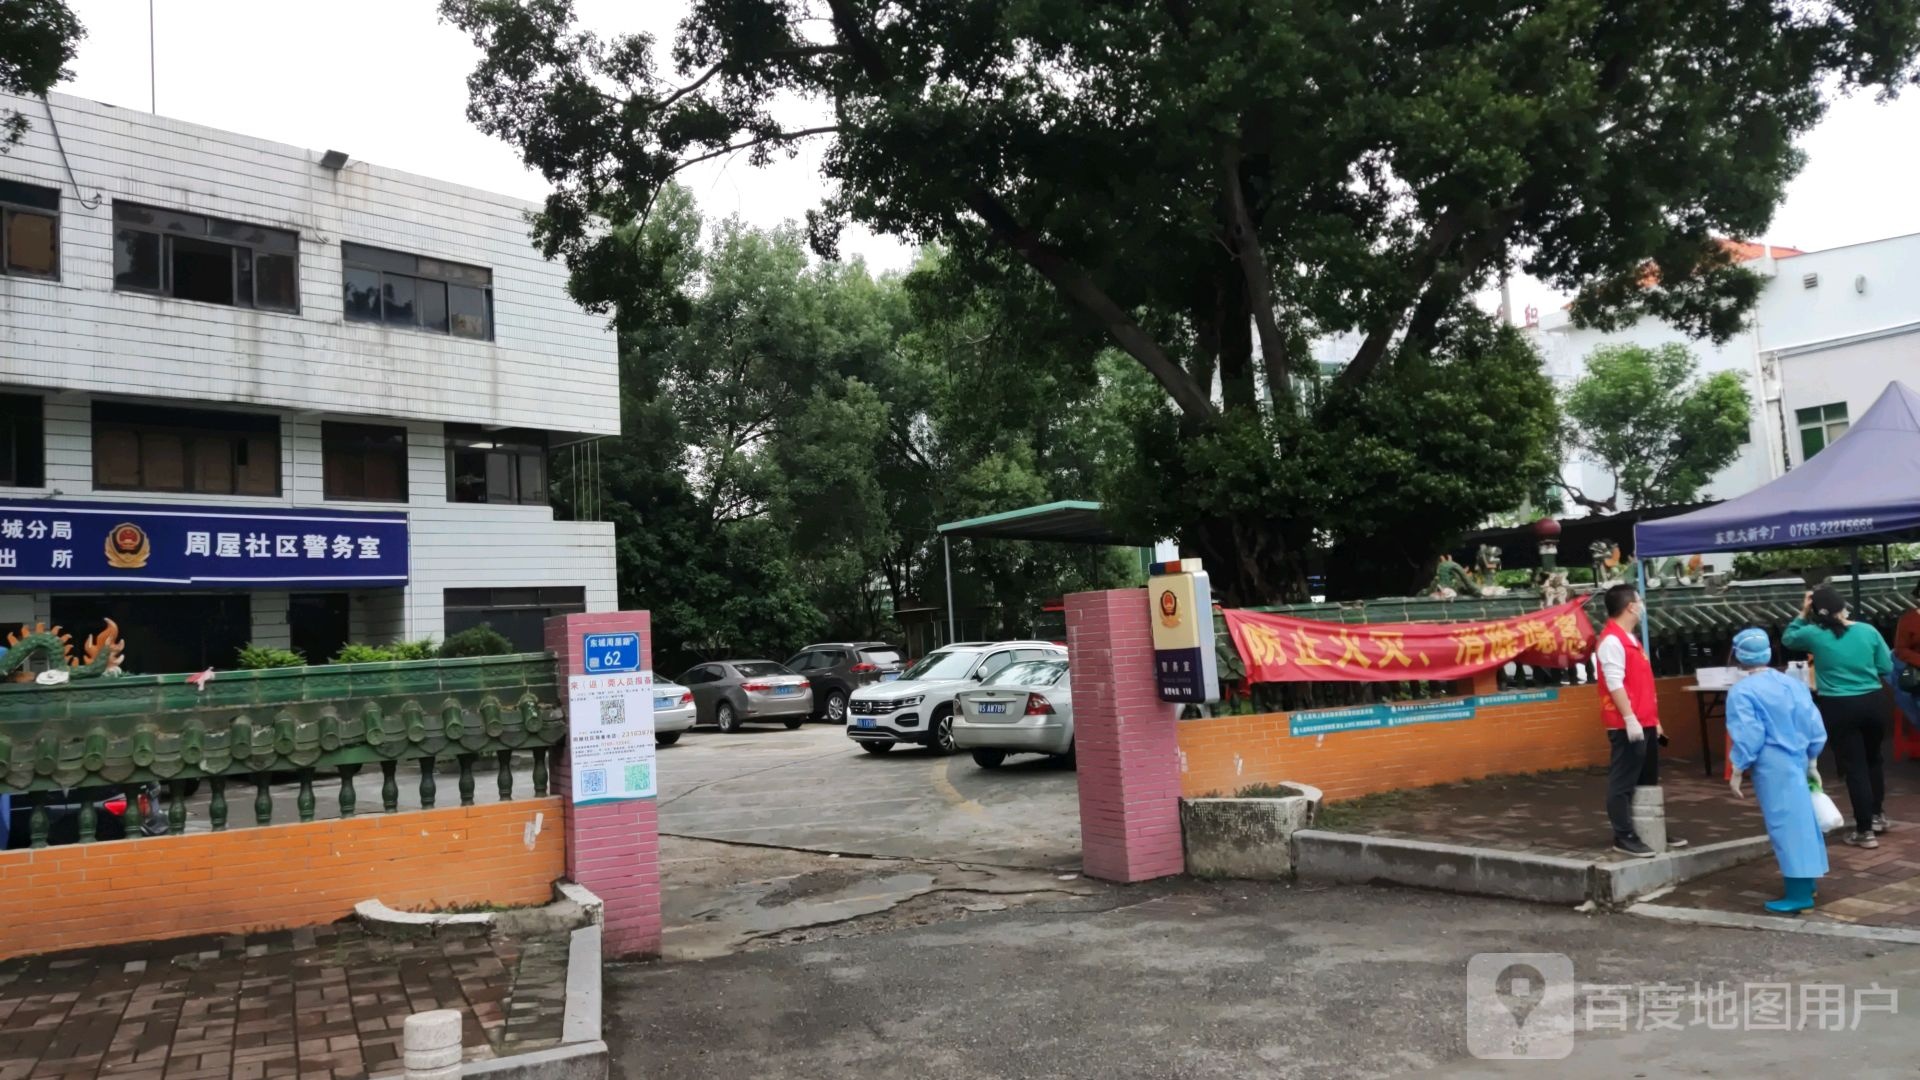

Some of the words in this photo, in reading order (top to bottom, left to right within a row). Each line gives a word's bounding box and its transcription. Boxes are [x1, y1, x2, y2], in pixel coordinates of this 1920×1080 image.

[1, 518, 73, 540] 城分局
[1714, 525, 1782, 545] 东莞大新伞厂
[184, 530, 381, 561] 周屋社区警务室
[604, 650, 621, 666] 62
